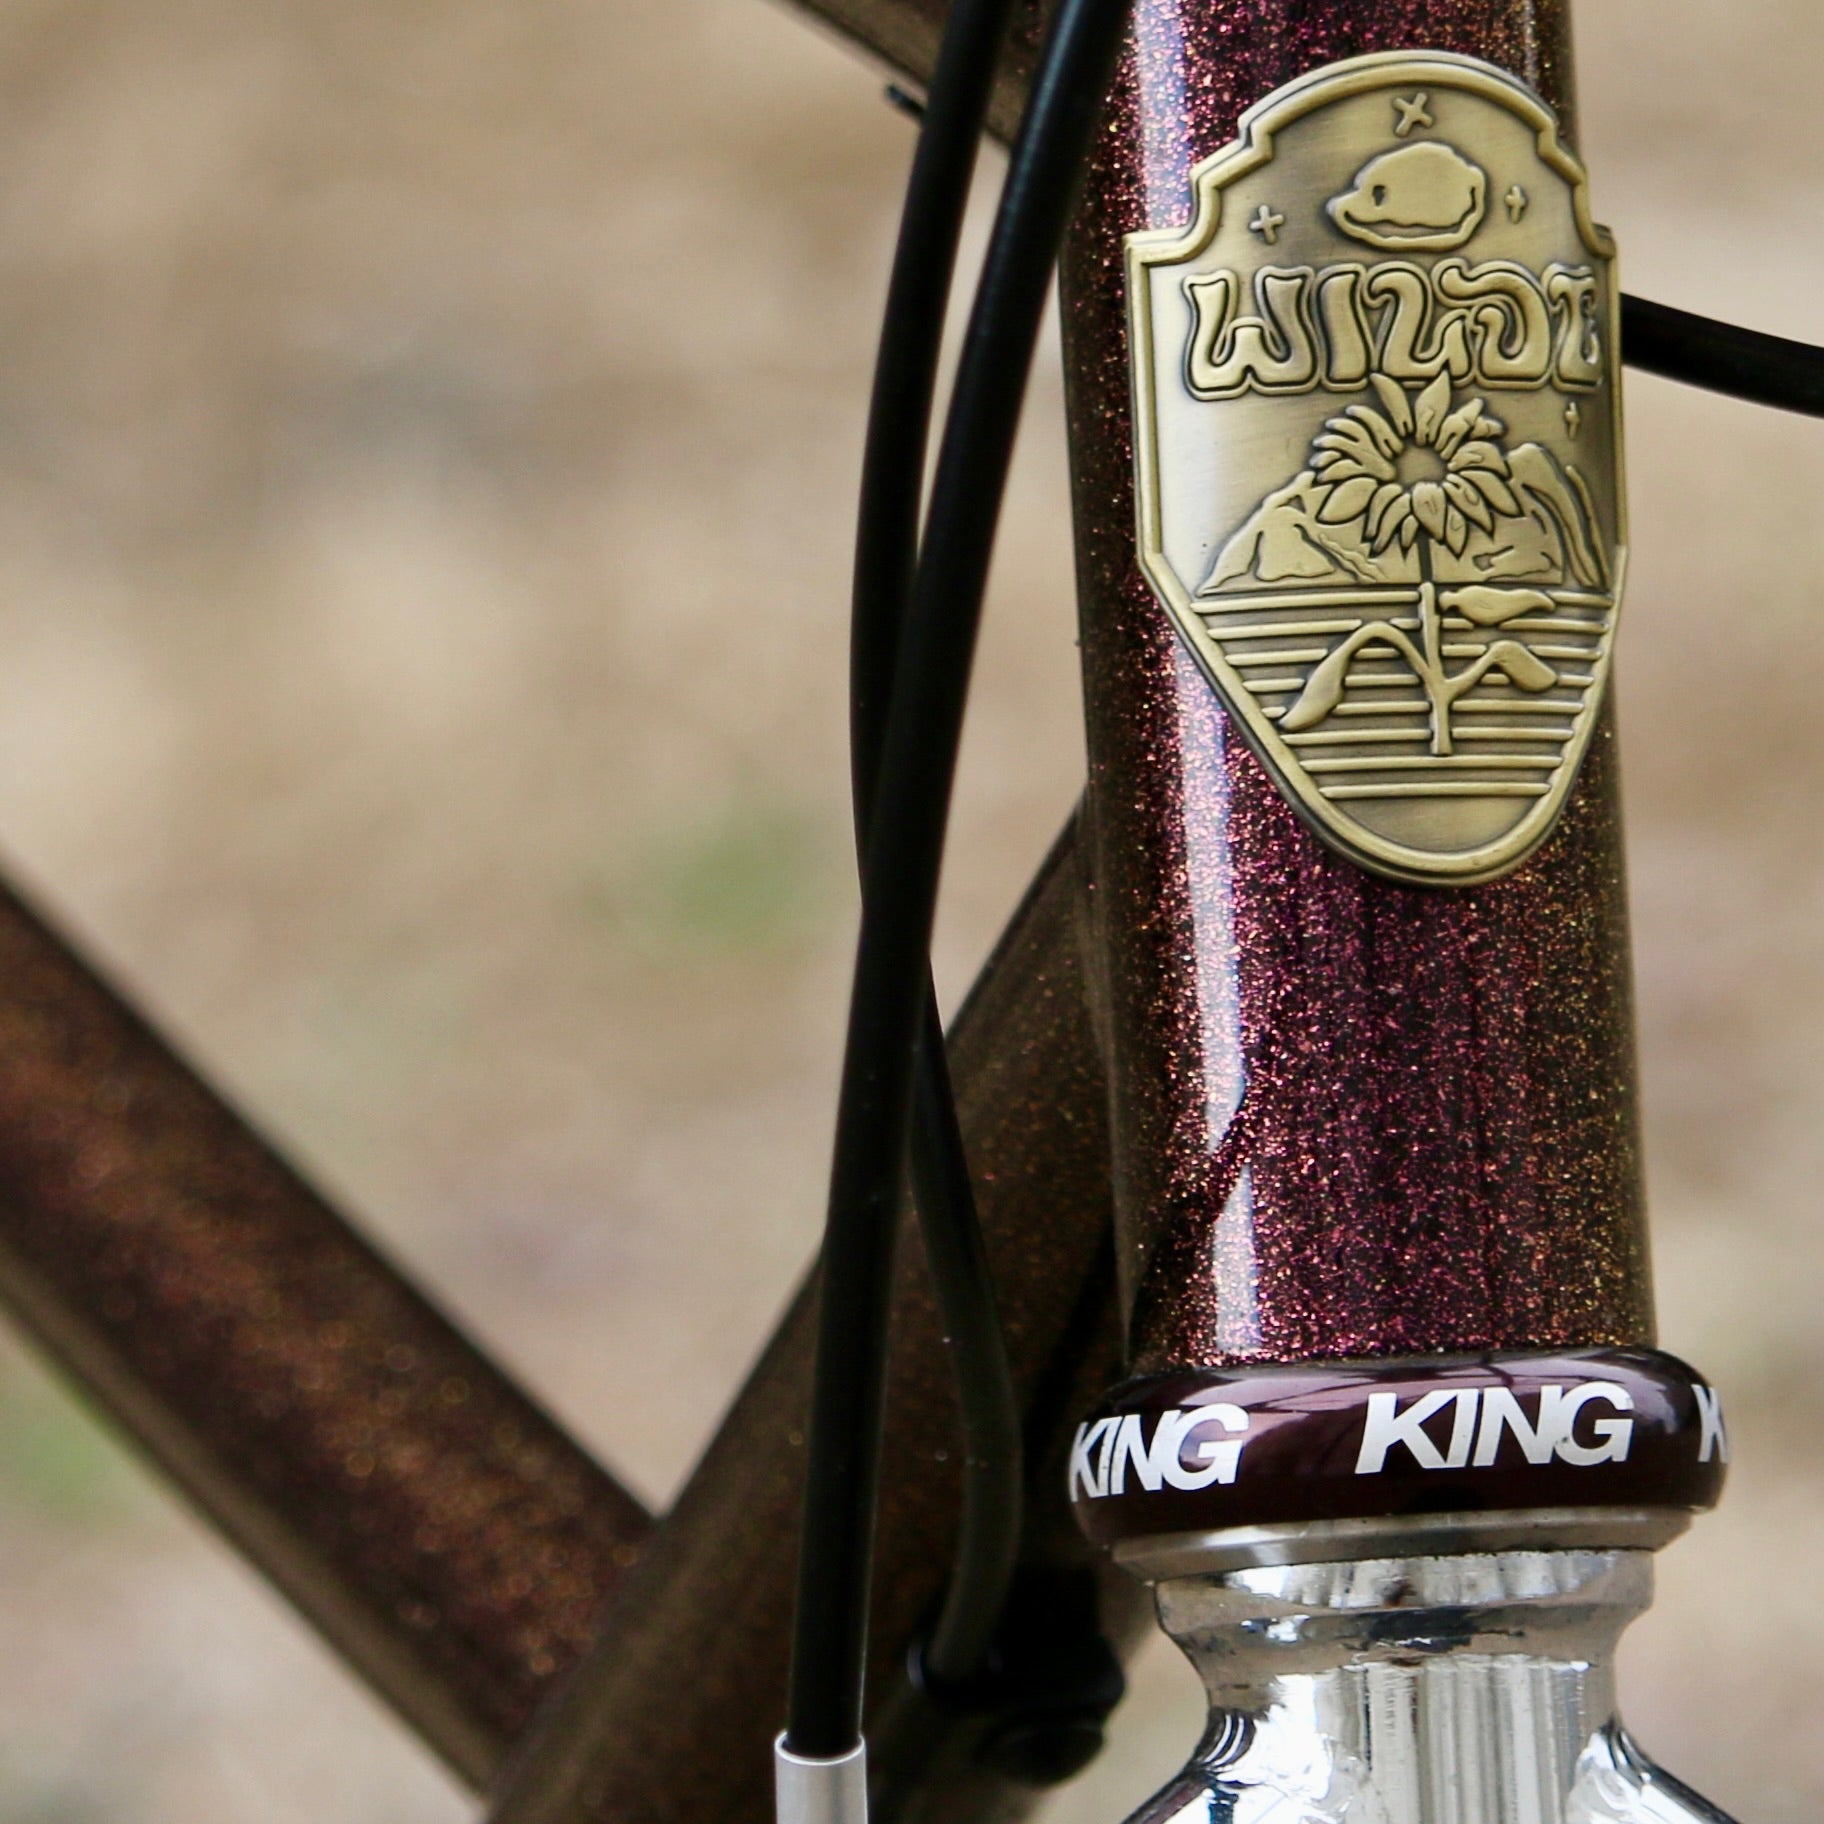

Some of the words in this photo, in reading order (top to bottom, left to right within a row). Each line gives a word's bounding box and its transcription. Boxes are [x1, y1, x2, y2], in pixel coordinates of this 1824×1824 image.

[1182, 257, 1605, 402] WILDE
[1071, 1402, 1251, 1502] KING
[1355, 1380, 1635, 1475] KING
